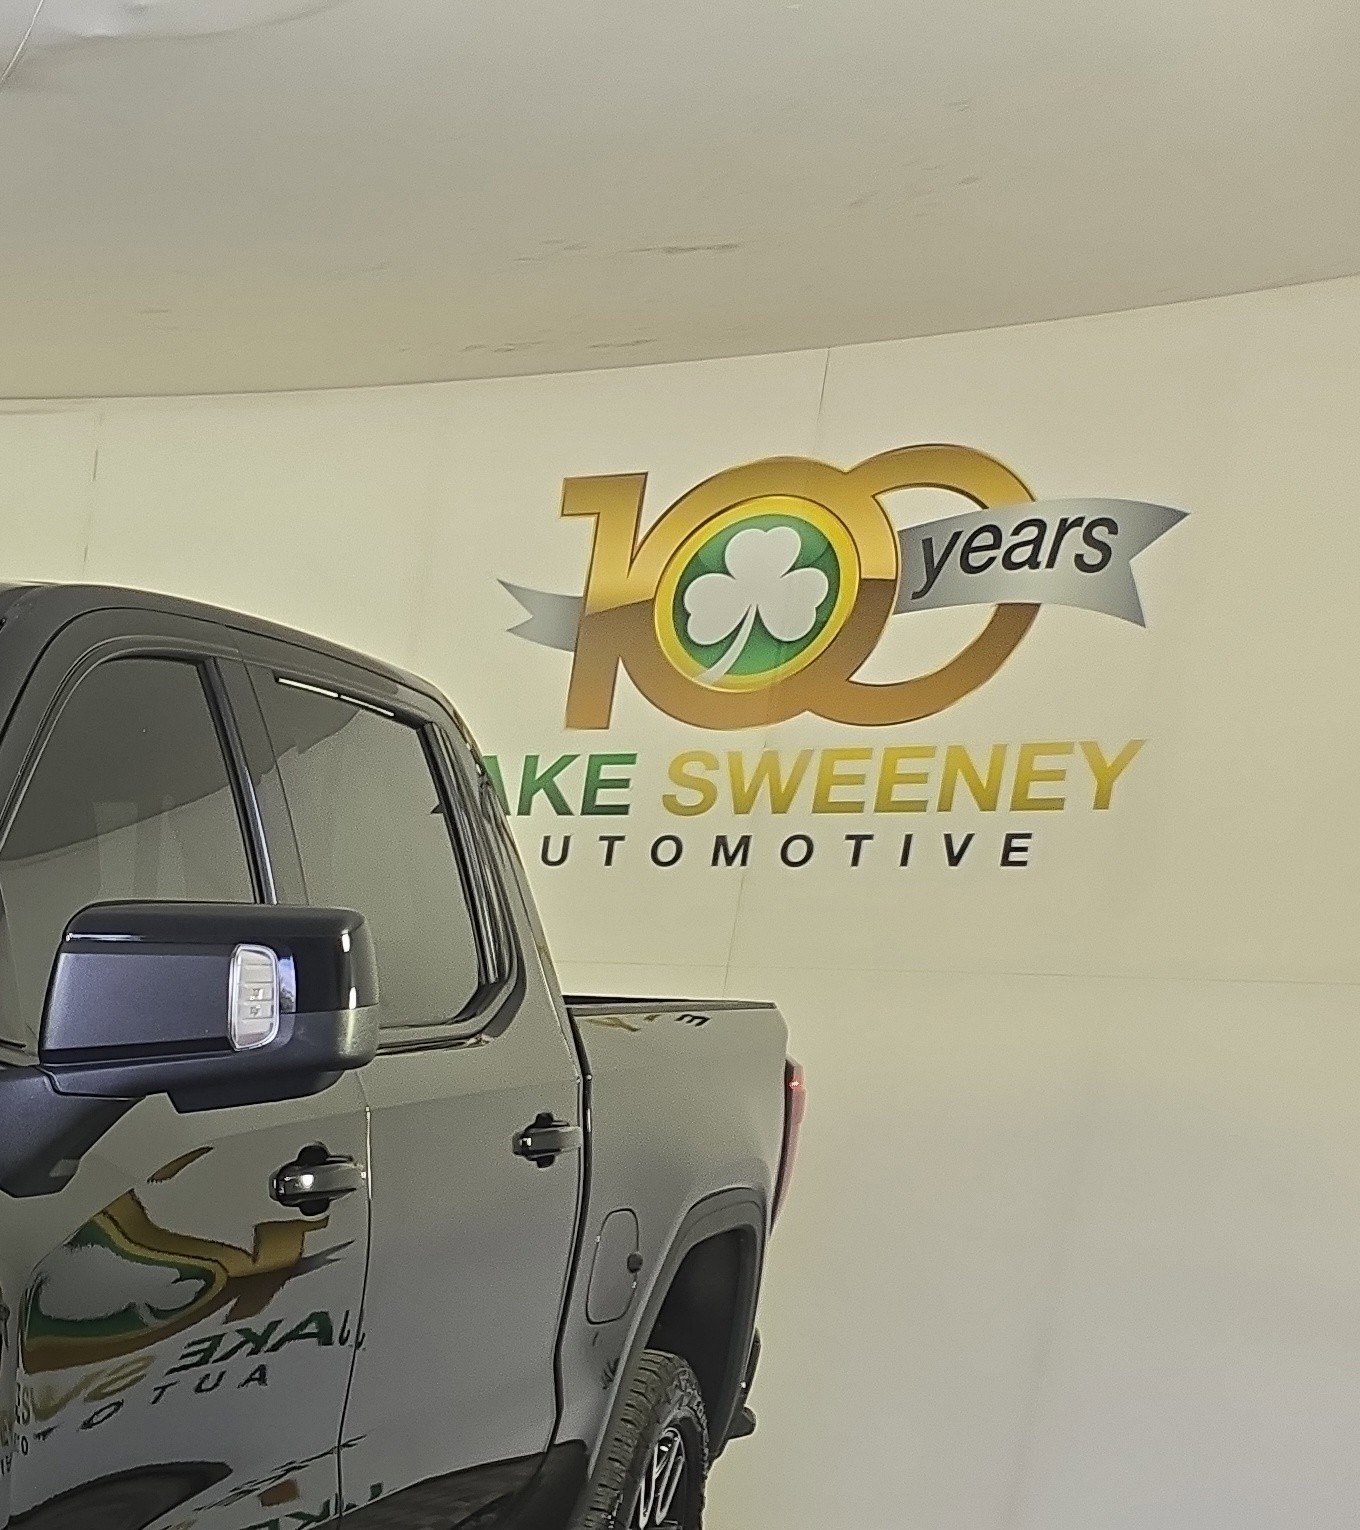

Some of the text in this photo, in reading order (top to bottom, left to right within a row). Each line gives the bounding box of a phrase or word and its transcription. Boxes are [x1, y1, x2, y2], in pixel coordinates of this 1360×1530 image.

[558, 442, 1120, 732] 100 years
[661, 738, 1147, 818] SWEENEY
[540, 832, 1034, 868] UTOMOTIVE
